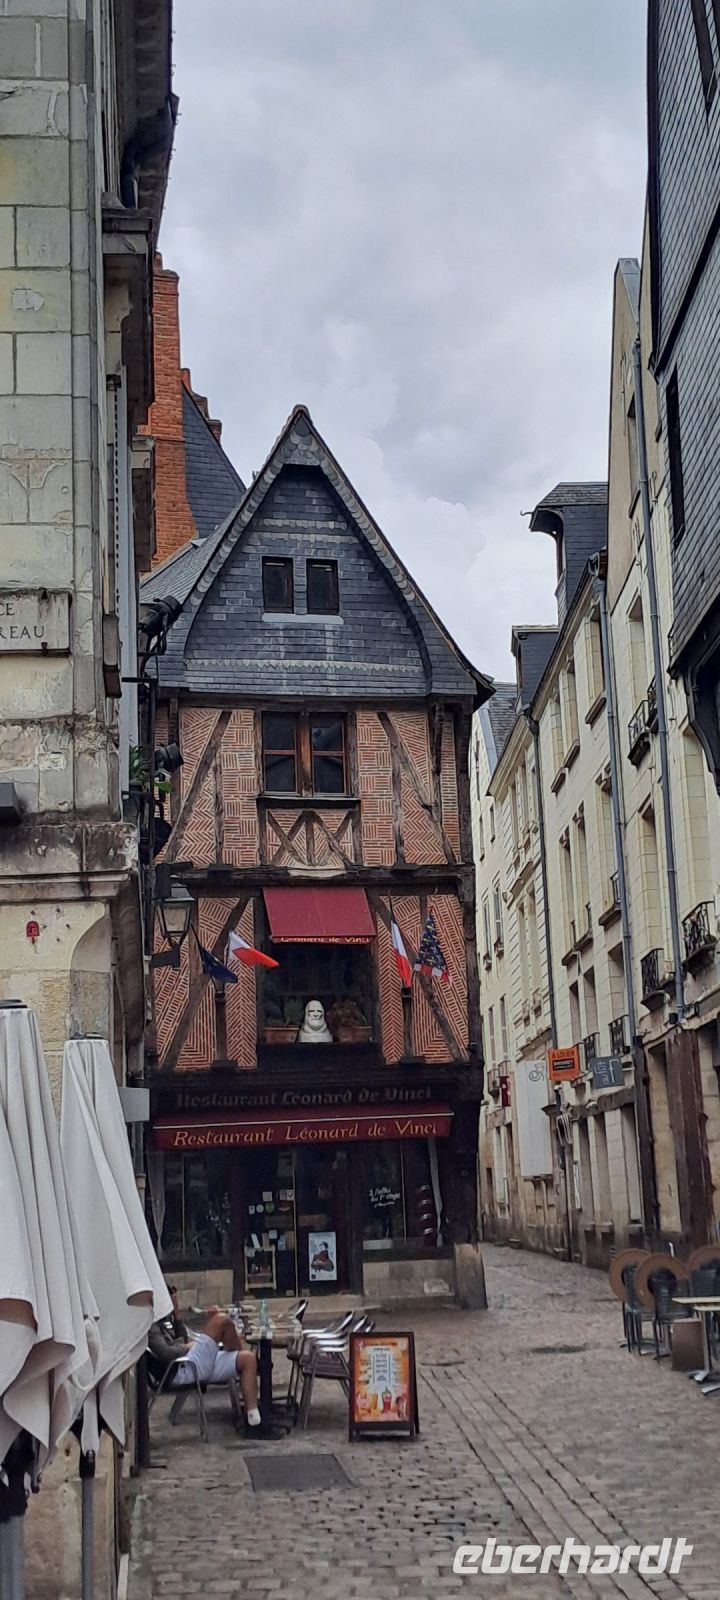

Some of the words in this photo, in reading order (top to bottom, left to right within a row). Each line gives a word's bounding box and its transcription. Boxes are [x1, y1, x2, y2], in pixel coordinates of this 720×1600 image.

[175, 1091, 276, 1108] Restaurant
[358, 1087, 380, 1103] de
[384, 1085, 432, 1102] Vinci
[173, 1127, 274, 1146] Restaurant
[285, 1123, 359, 1141] Léonard
[367, 1122, 386, 1137] de
[394, 1119, 438, 1136] Vinci
